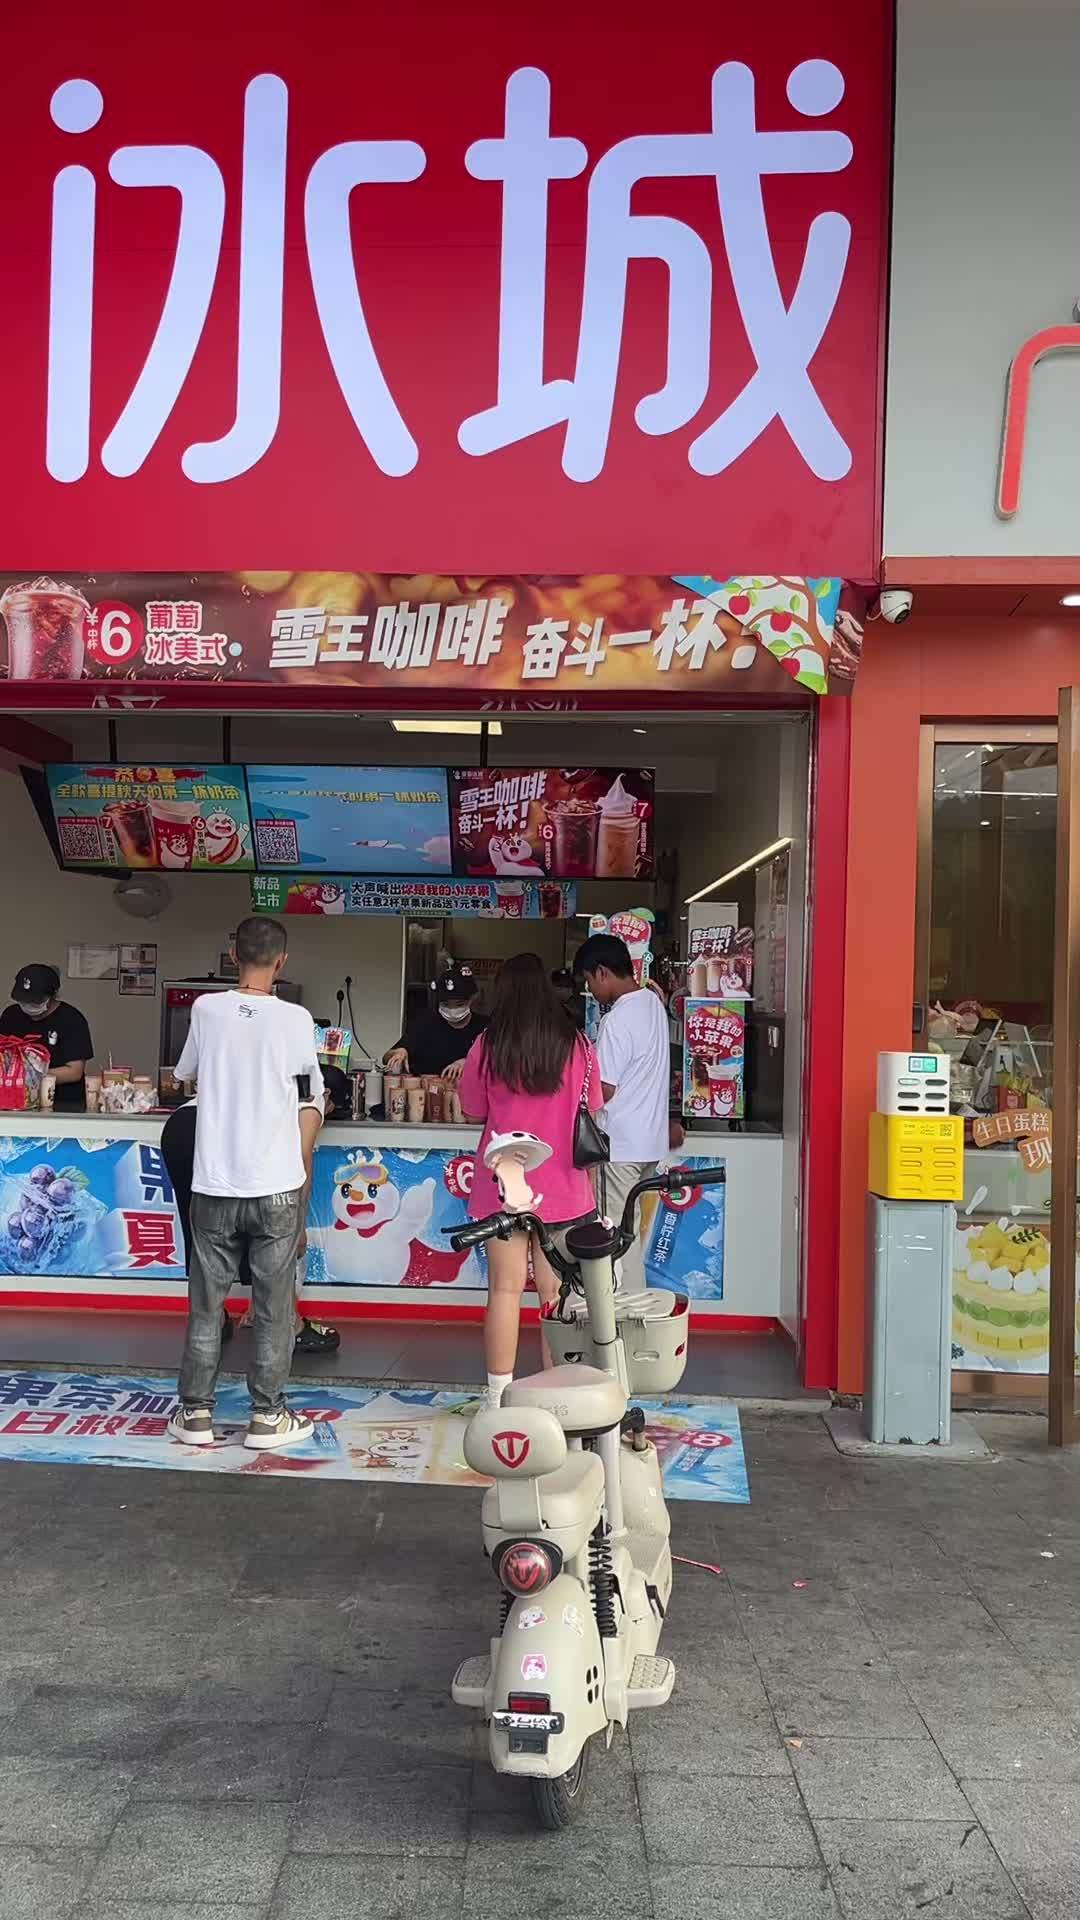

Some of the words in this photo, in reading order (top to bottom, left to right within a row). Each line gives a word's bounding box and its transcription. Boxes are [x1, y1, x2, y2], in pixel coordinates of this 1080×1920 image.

[46, 59, 853, 484] 冰城
[147, 602, 201, 631] 葡萄
[146, 633, 226, 665] 冰美式
[269, 599, 511, 669] 雪王咖啡
[459, 770, 548, 813] 雪王咖啡
[254, 877, 280, 890] 新品
[254, 893, 280, 907] 上市
[687, 1015, 742, 1037] 你是我的
[690, 1030, 734, 1048] 小苹果
[976, 1112, 1049, 1140] 生日蛋糕
[1022, 1137, 1052, 1168] 现
[122, 1210, 179, 1268] 夏
[0, 1376, 179, 1419] 果茶加
[0, 1409, 170, 1436] 日救星
